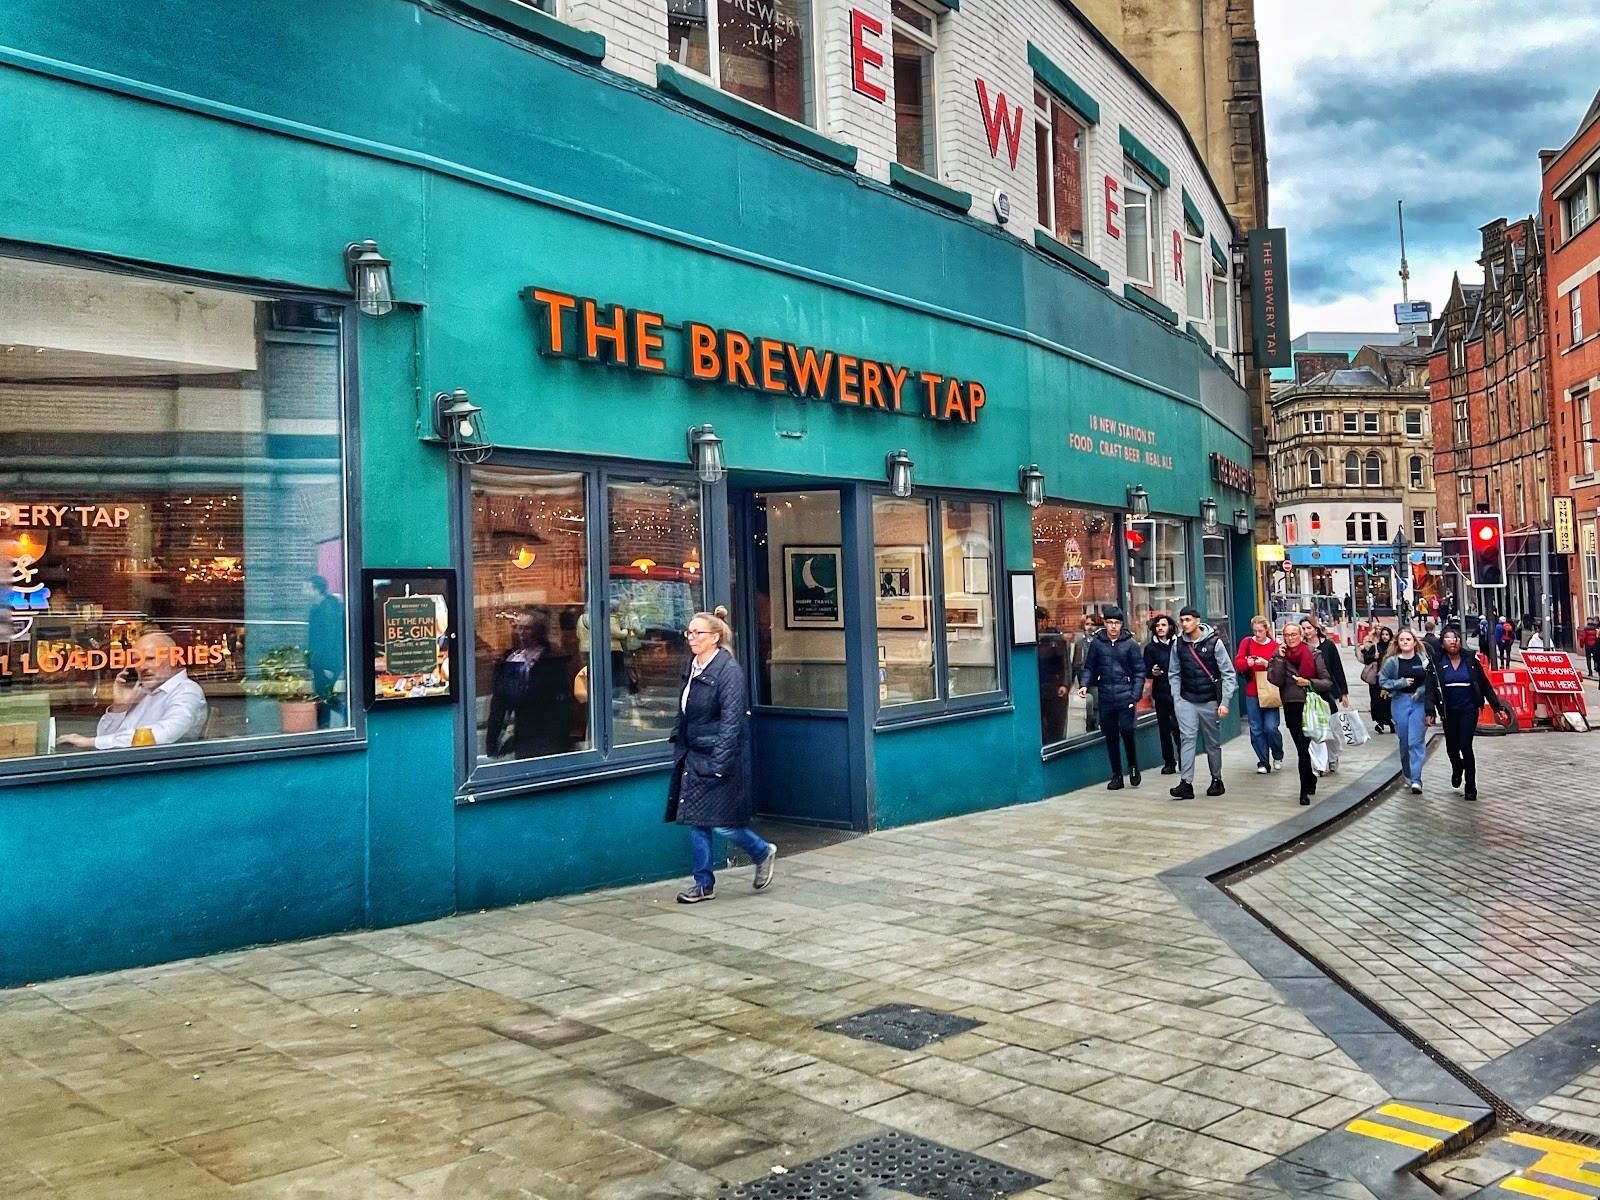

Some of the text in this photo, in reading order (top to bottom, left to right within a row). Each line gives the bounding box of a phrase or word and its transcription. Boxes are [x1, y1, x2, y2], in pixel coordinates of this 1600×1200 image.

[750, 22, 783, 52] TAP
[1263, 240, 1276, 356] THE BREWERY TAP
[533, 289, 987, 424] THE BREWERY TAP
[1089, 414, 1098, 431] 18
[1100, 417, 1117, 435] NEW
[1118, 422, 1147, 442] STATION
[1069, 433, 1173, 470] FOOD CRAFT BEER REAL ALE
[75, 505, 130, 527] TAP
[1559, 500, 1570, 550] PIZZERIA
[387, 616, 434, 626] LET THE FUN
[388, 626, 434, 639] BE-GIN
[22, 648, 147, 674] LOADED
[155, 644, 223, 667] FRIES
[1528, 667, 1574, 675] LIGHT SHOWS
[1549, 655, 1564, 663] RED
[1537, 680, 1578, 689] WAIT HERE
[1339, 713, 1356, 745] M&S
